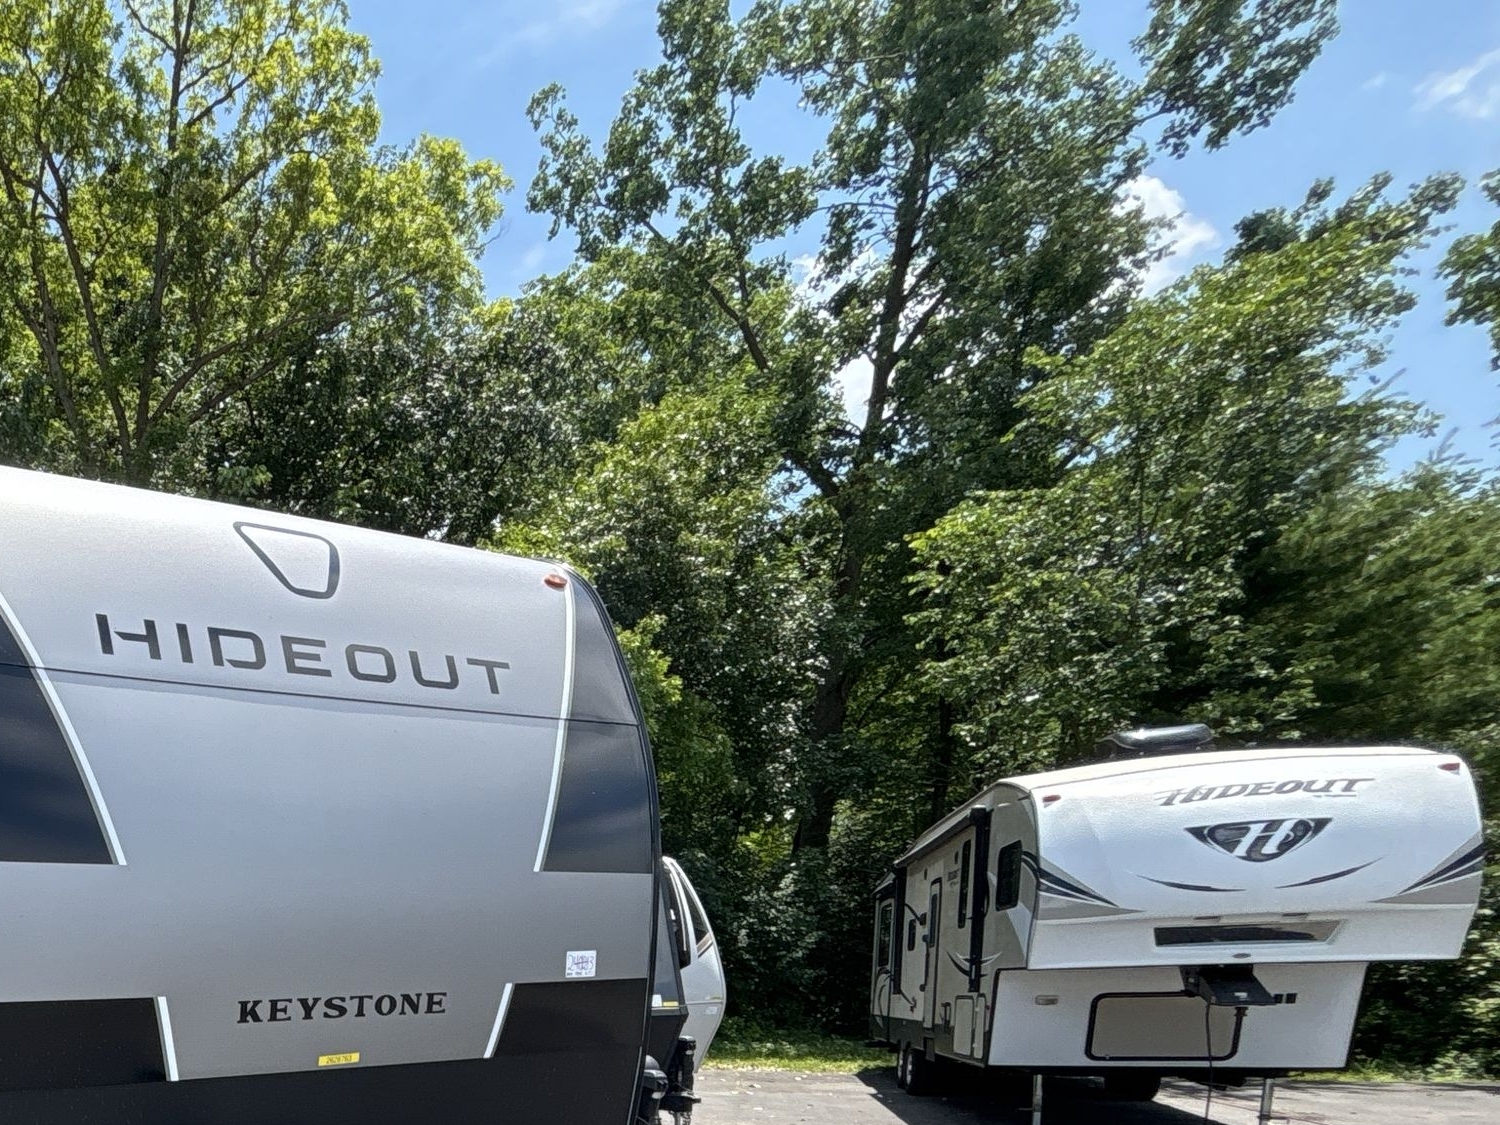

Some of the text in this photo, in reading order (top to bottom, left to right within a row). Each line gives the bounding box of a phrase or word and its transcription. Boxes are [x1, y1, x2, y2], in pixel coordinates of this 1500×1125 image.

[95, 612, 511, 695] HIDEOUT
[1153, 778, 1376, 807] HIDEOUT
[237, 992, 448, 1024] KEYSTONE
